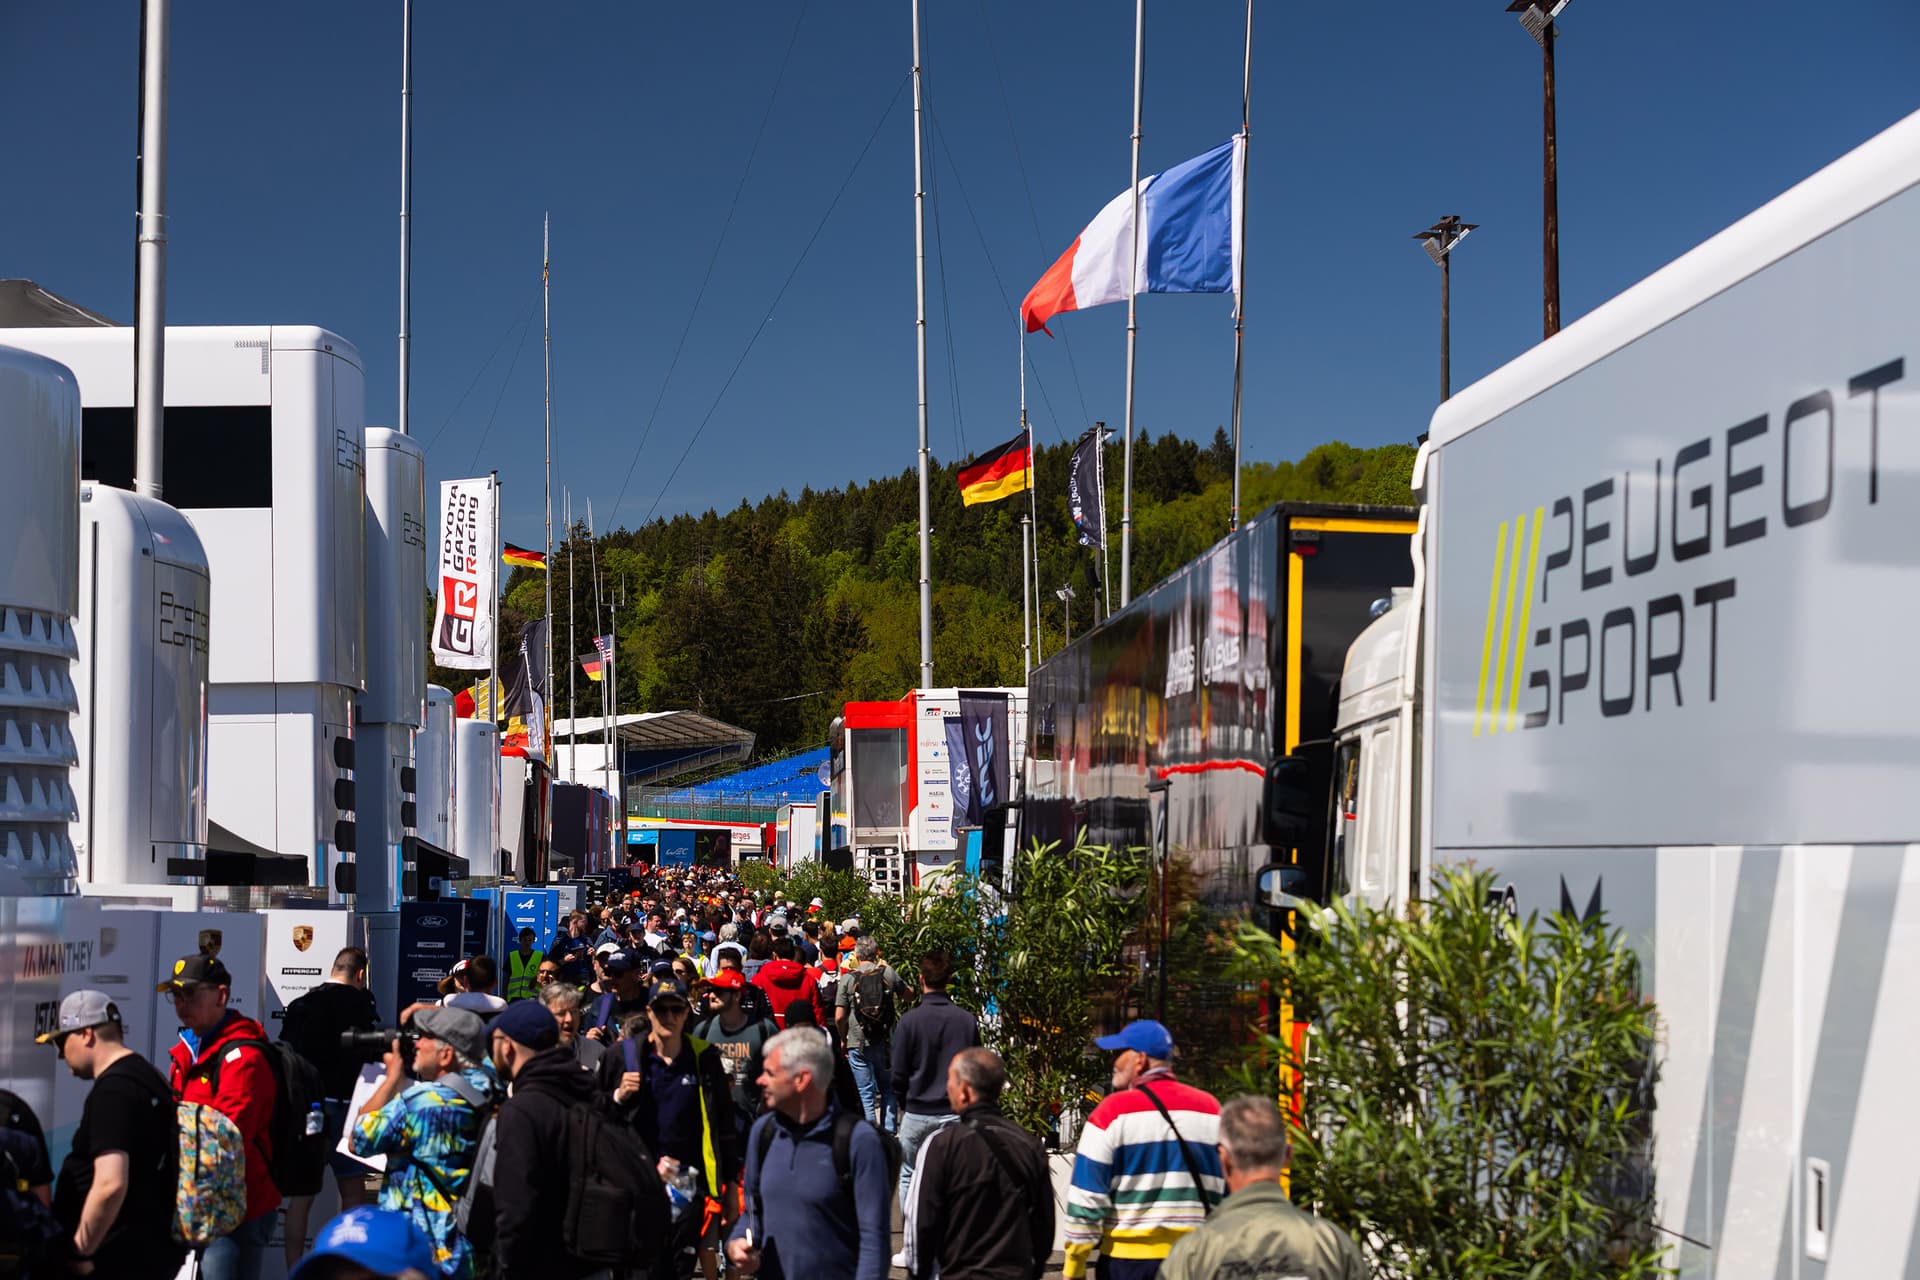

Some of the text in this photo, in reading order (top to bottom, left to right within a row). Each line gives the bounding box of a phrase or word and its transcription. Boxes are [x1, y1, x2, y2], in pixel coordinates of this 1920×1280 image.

[1542, 356, 1905, 603] PEUGEOT
[443, 485, 459, 569] TOYOTA
[453, 493, 467, 572] GAZOO
[465, 496, 479, 575] Racing
[451, 581, 477, 653] GR
[1523, 576, 1737, 730] SPORT
[665, 847, 689, 855] WEC
[38, 939, 94, 976] MANTHEY
[422, 916, 442, 926] Ford
[714, 1041, 750, 1058] EGON
